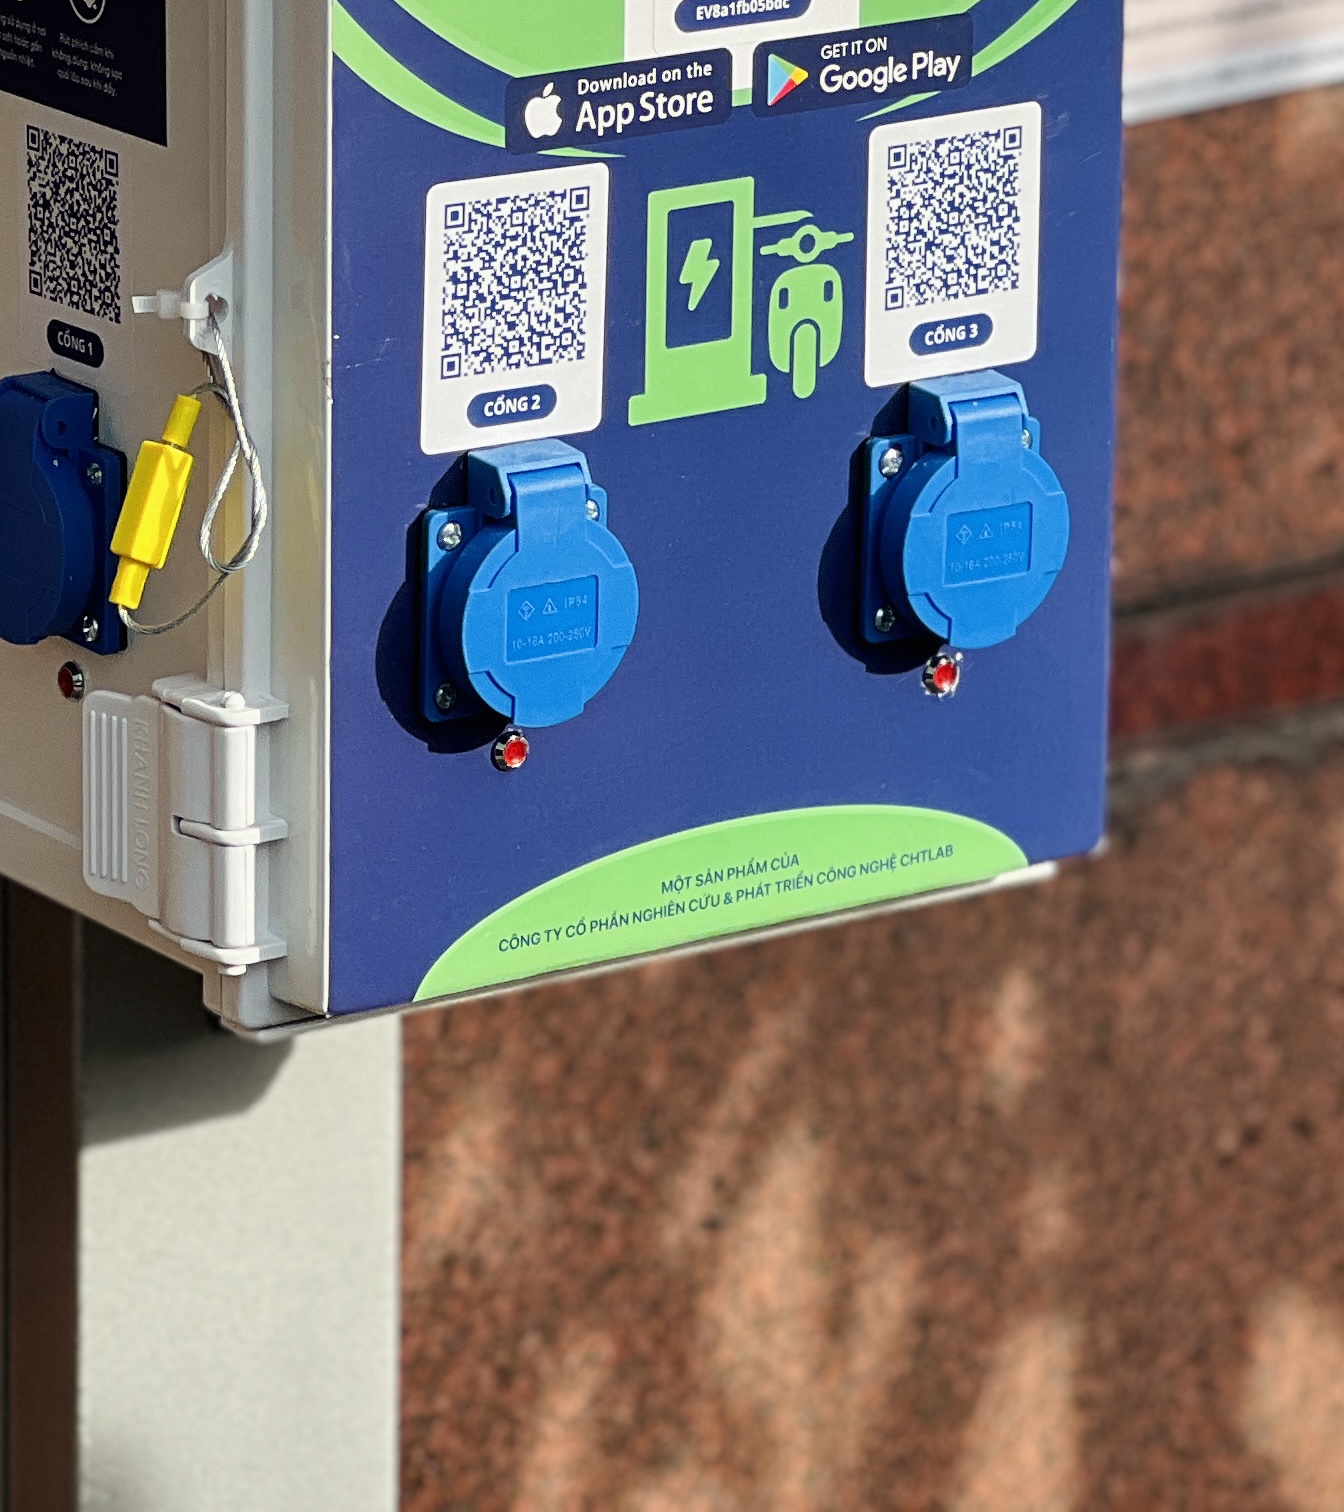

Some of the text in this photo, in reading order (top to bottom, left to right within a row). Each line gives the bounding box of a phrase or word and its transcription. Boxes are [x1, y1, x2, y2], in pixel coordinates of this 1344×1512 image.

[820, 36, 888, 60] GET IT ON
[577, 61, 713, 96] Download on the
[819, 50, 962, 93] Google Play
[575, 89, 714, 137] App Store
[57, 327, 93, 357] CỔNG 1
[924, 323, 979, 346] CỔNG 3
[483, 393, 541, 417] CỔNG 2
[661, 874, 692, 895] MỘT
[695, 867, 724, 887] SẢN
[770, 851, 800, 871] CỦA
[498, 932, 541, 952] CÔNG
[544, 927, 563, 942] TY
[565, 915, 587, 938] CỔ
[632, 900, 686, 924] NGHIÊN
[688, 892, 721, 913] CỨU
[723, 892, 733, 905] &
[736, 882, 772, 902] PHÁT
[775, 870, 814, 894] TRIỂN
[816, 865, 857, 885] CÔNG
[859, 852, 897, 877] NGHỆ
[900, 844, 954, 868] CHTLAB
